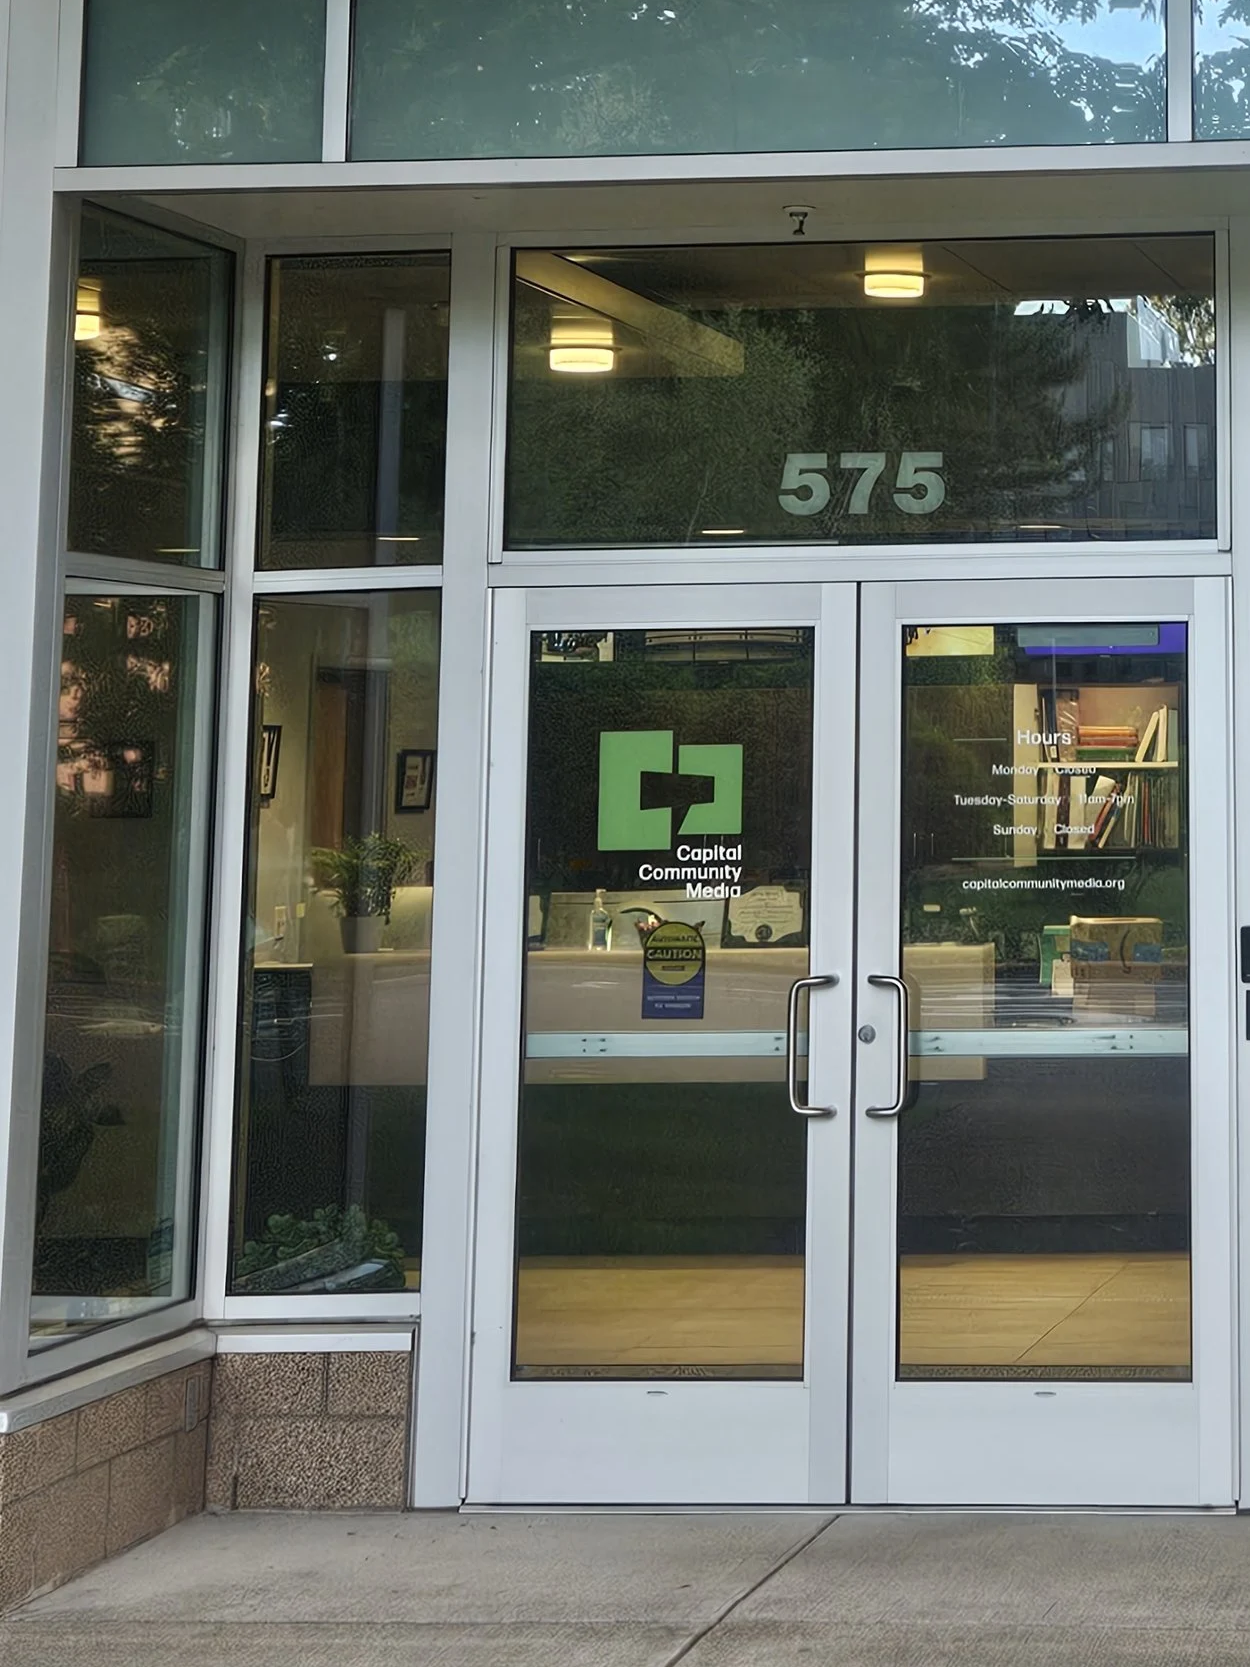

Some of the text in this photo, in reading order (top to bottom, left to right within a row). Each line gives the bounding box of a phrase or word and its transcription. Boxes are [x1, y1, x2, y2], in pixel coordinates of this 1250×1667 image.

[778, 452, 946, 516] 575
[1017, 730, 1072, 745] Hours
[992, 764, 1038, 776] Monday
[954, 795, 1062, 806] Tuesday-Saturday
[993, 824, 1095, 835] Sunday Closed
[677, 845, 742, 864] Capital
[639, 864, 742, 882] Community
[686, 883, 741, 898] Media
[962, 878, 1125, 890] capitalcommunitymedia.org
[647, 949, 701, 959] CAUTION
